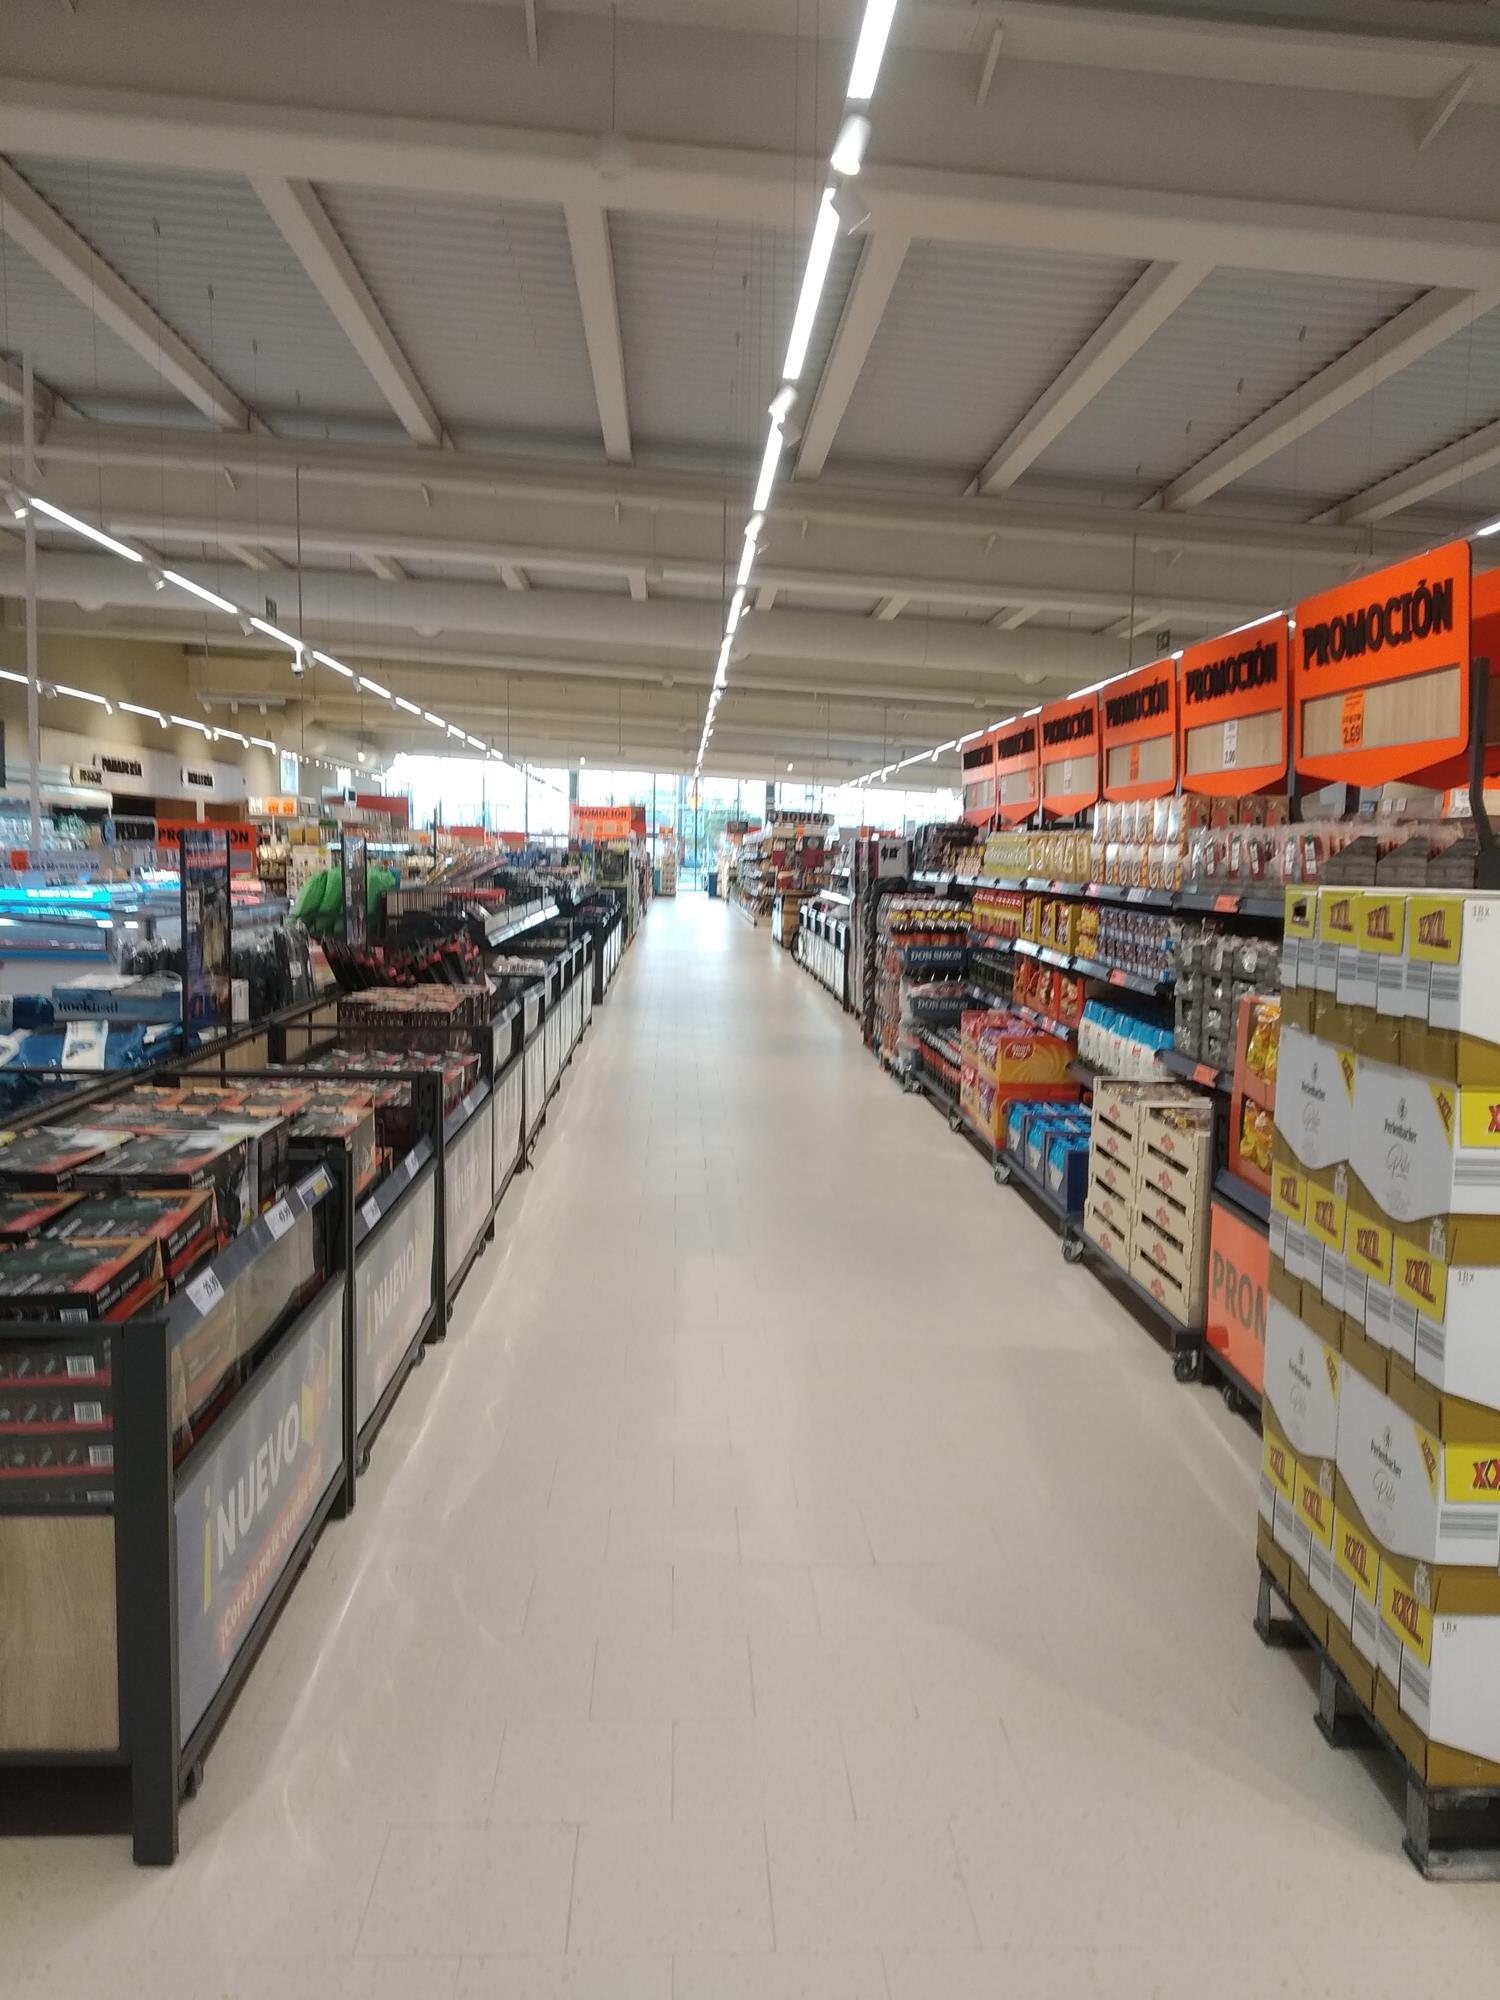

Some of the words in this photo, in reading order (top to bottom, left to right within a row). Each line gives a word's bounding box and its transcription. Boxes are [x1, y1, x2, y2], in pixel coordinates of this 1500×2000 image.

[1303, 577, 1453, 671] PROMOCIÓN
[1186, 641, 1278, 705] PROMOCIÓN
[1106, 677, 1169, 729] PROMOCIÓN
[1042, 706, 1094, 747] PROMOCIÓN
[1367, 904, 1395, 941] XXL
[1418, 909, 1452, 949] XXL
[1384, 1117, 1417, 1144] Perlenbacher
[1280, 1176, 1299, 1210] XXL
[1315, 1200, 1338, 1238] XXL
[1357, 1227, 1384, 1270] XXL
[1405, 1257, 1437, 1304] XXL
[1270, 1447, 1288, 1488] XXL
[1370, 1439, 1402, 1479] Perlenbacher
[1303, 1487, 1326, 1532] XXL
[1344, 1532, 1371, 1588] XXL
[1392, 1588, 1424, 1648] XXL
